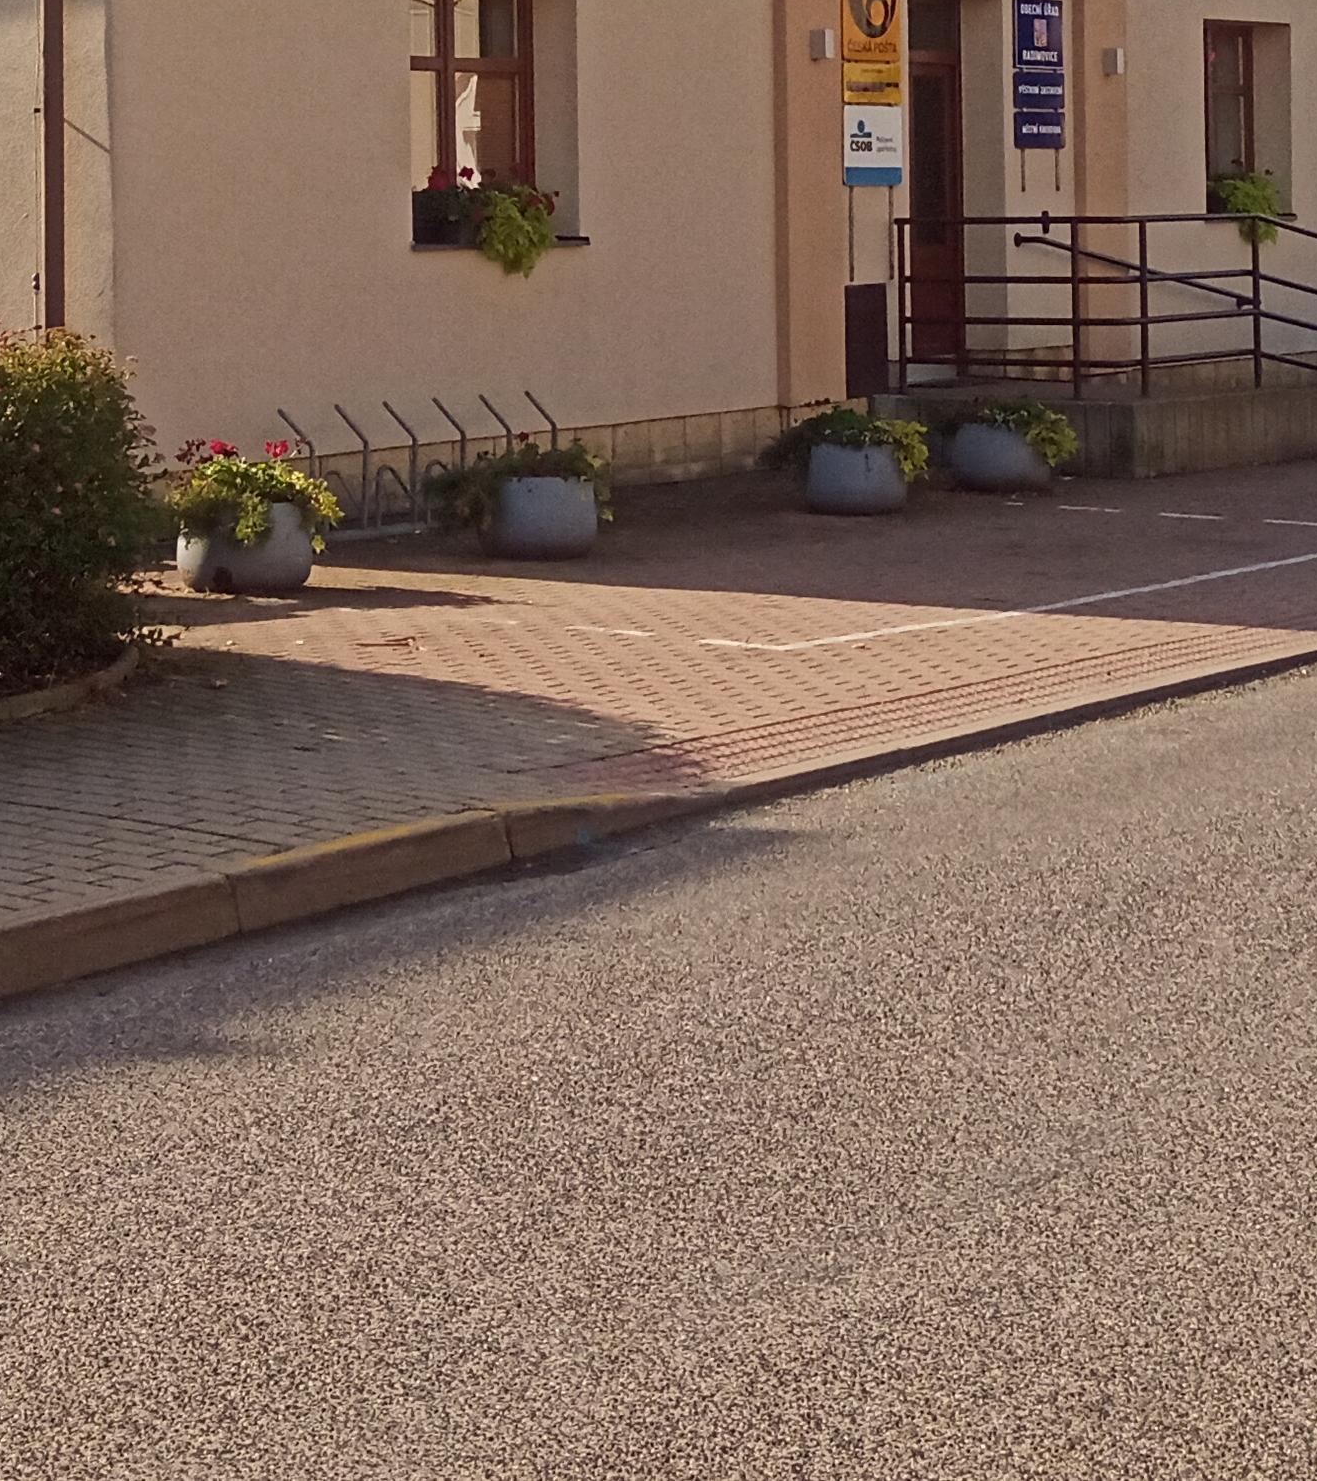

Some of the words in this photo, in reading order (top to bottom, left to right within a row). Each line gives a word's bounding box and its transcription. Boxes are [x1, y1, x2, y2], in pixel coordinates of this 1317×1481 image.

[1021, 2, 1042, 15] OBECNÍ
[874, 40, 897, 53] POŠTA
[850, 139, 873, 152] ČSOB
